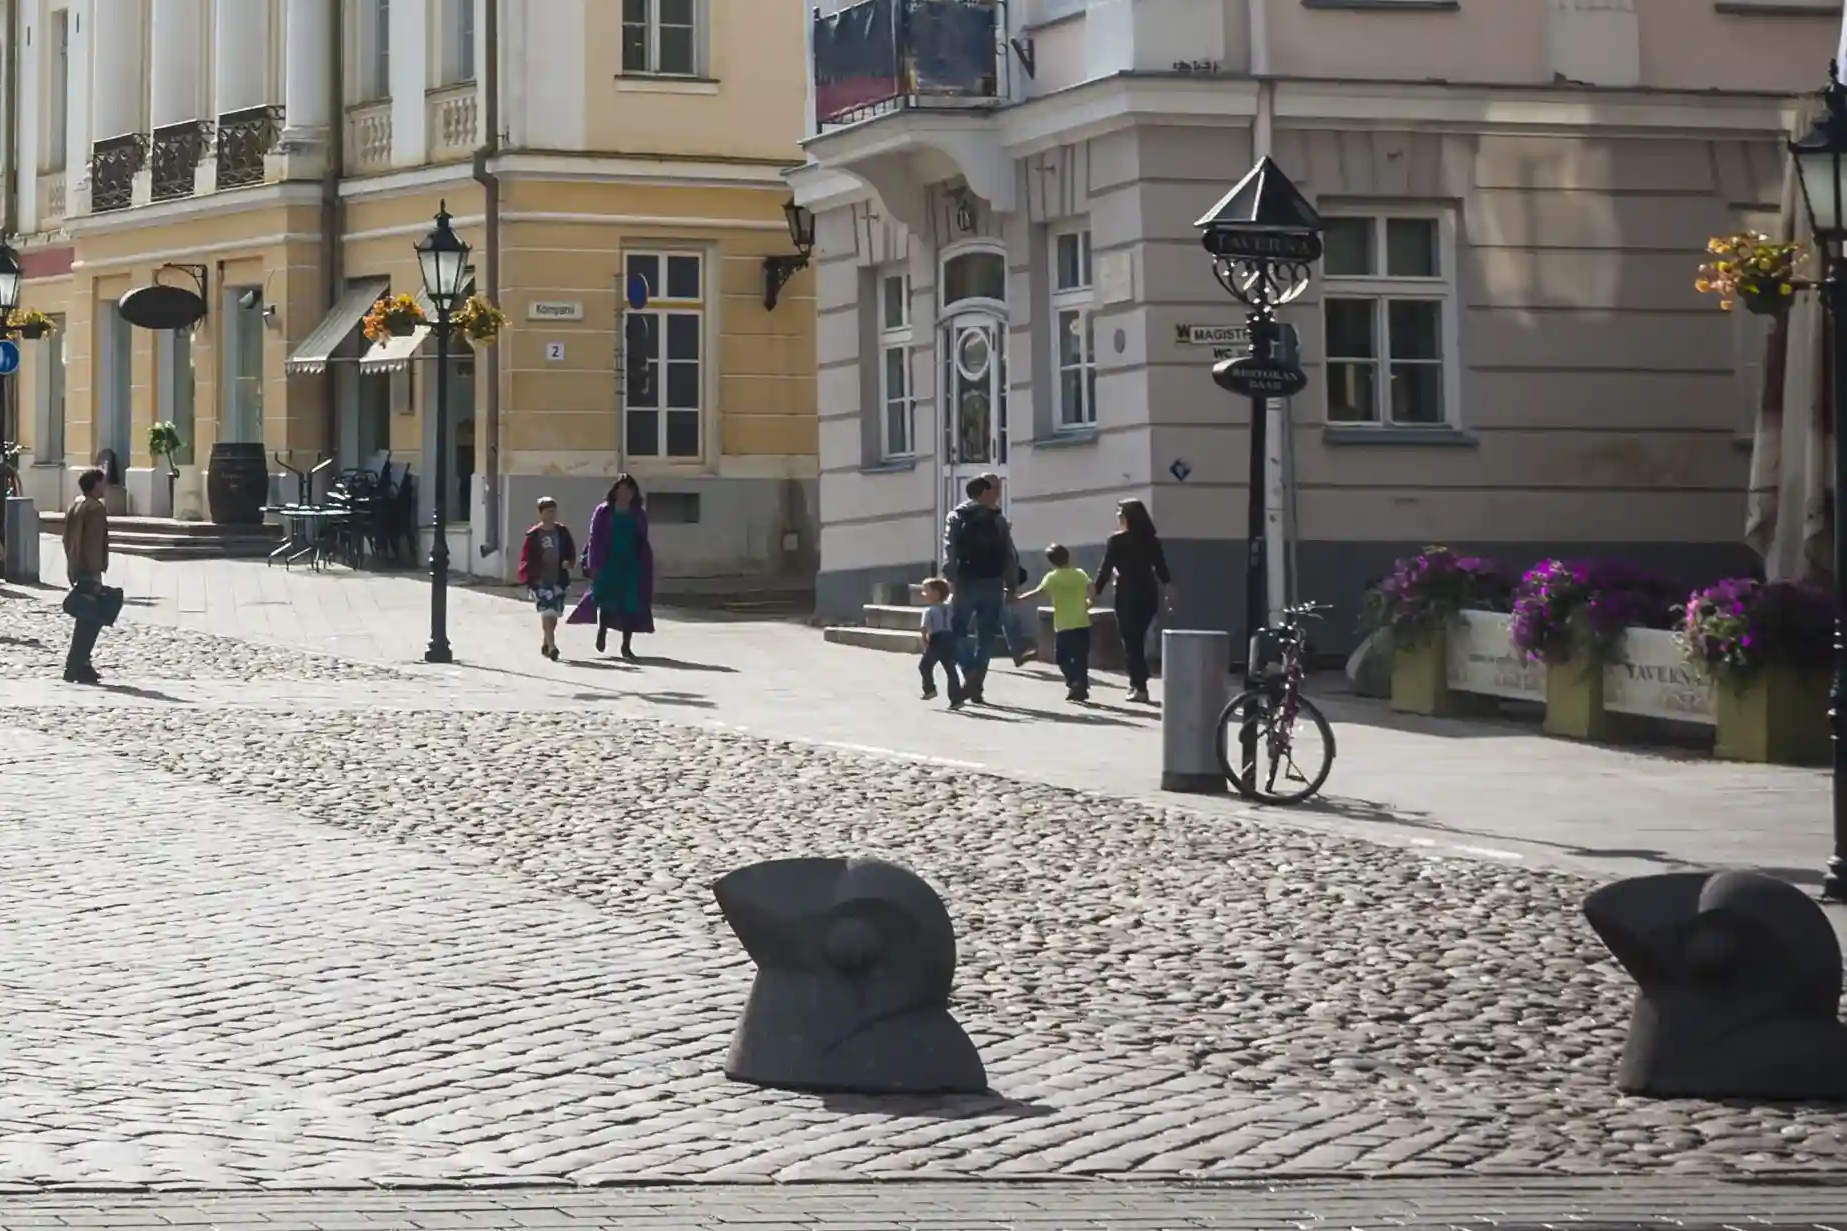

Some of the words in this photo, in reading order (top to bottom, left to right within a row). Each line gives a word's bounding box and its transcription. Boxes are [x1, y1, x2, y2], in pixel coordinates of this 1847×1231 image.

[1216, 233, 1311, 255] TAVERNA
[1194, 329, 1252, 341] MAGISTR
[551, 346, 560, 358] 2
[1213, 348, 1233, 359] WC
[1624, 663, 1691, 686] TAVERN
